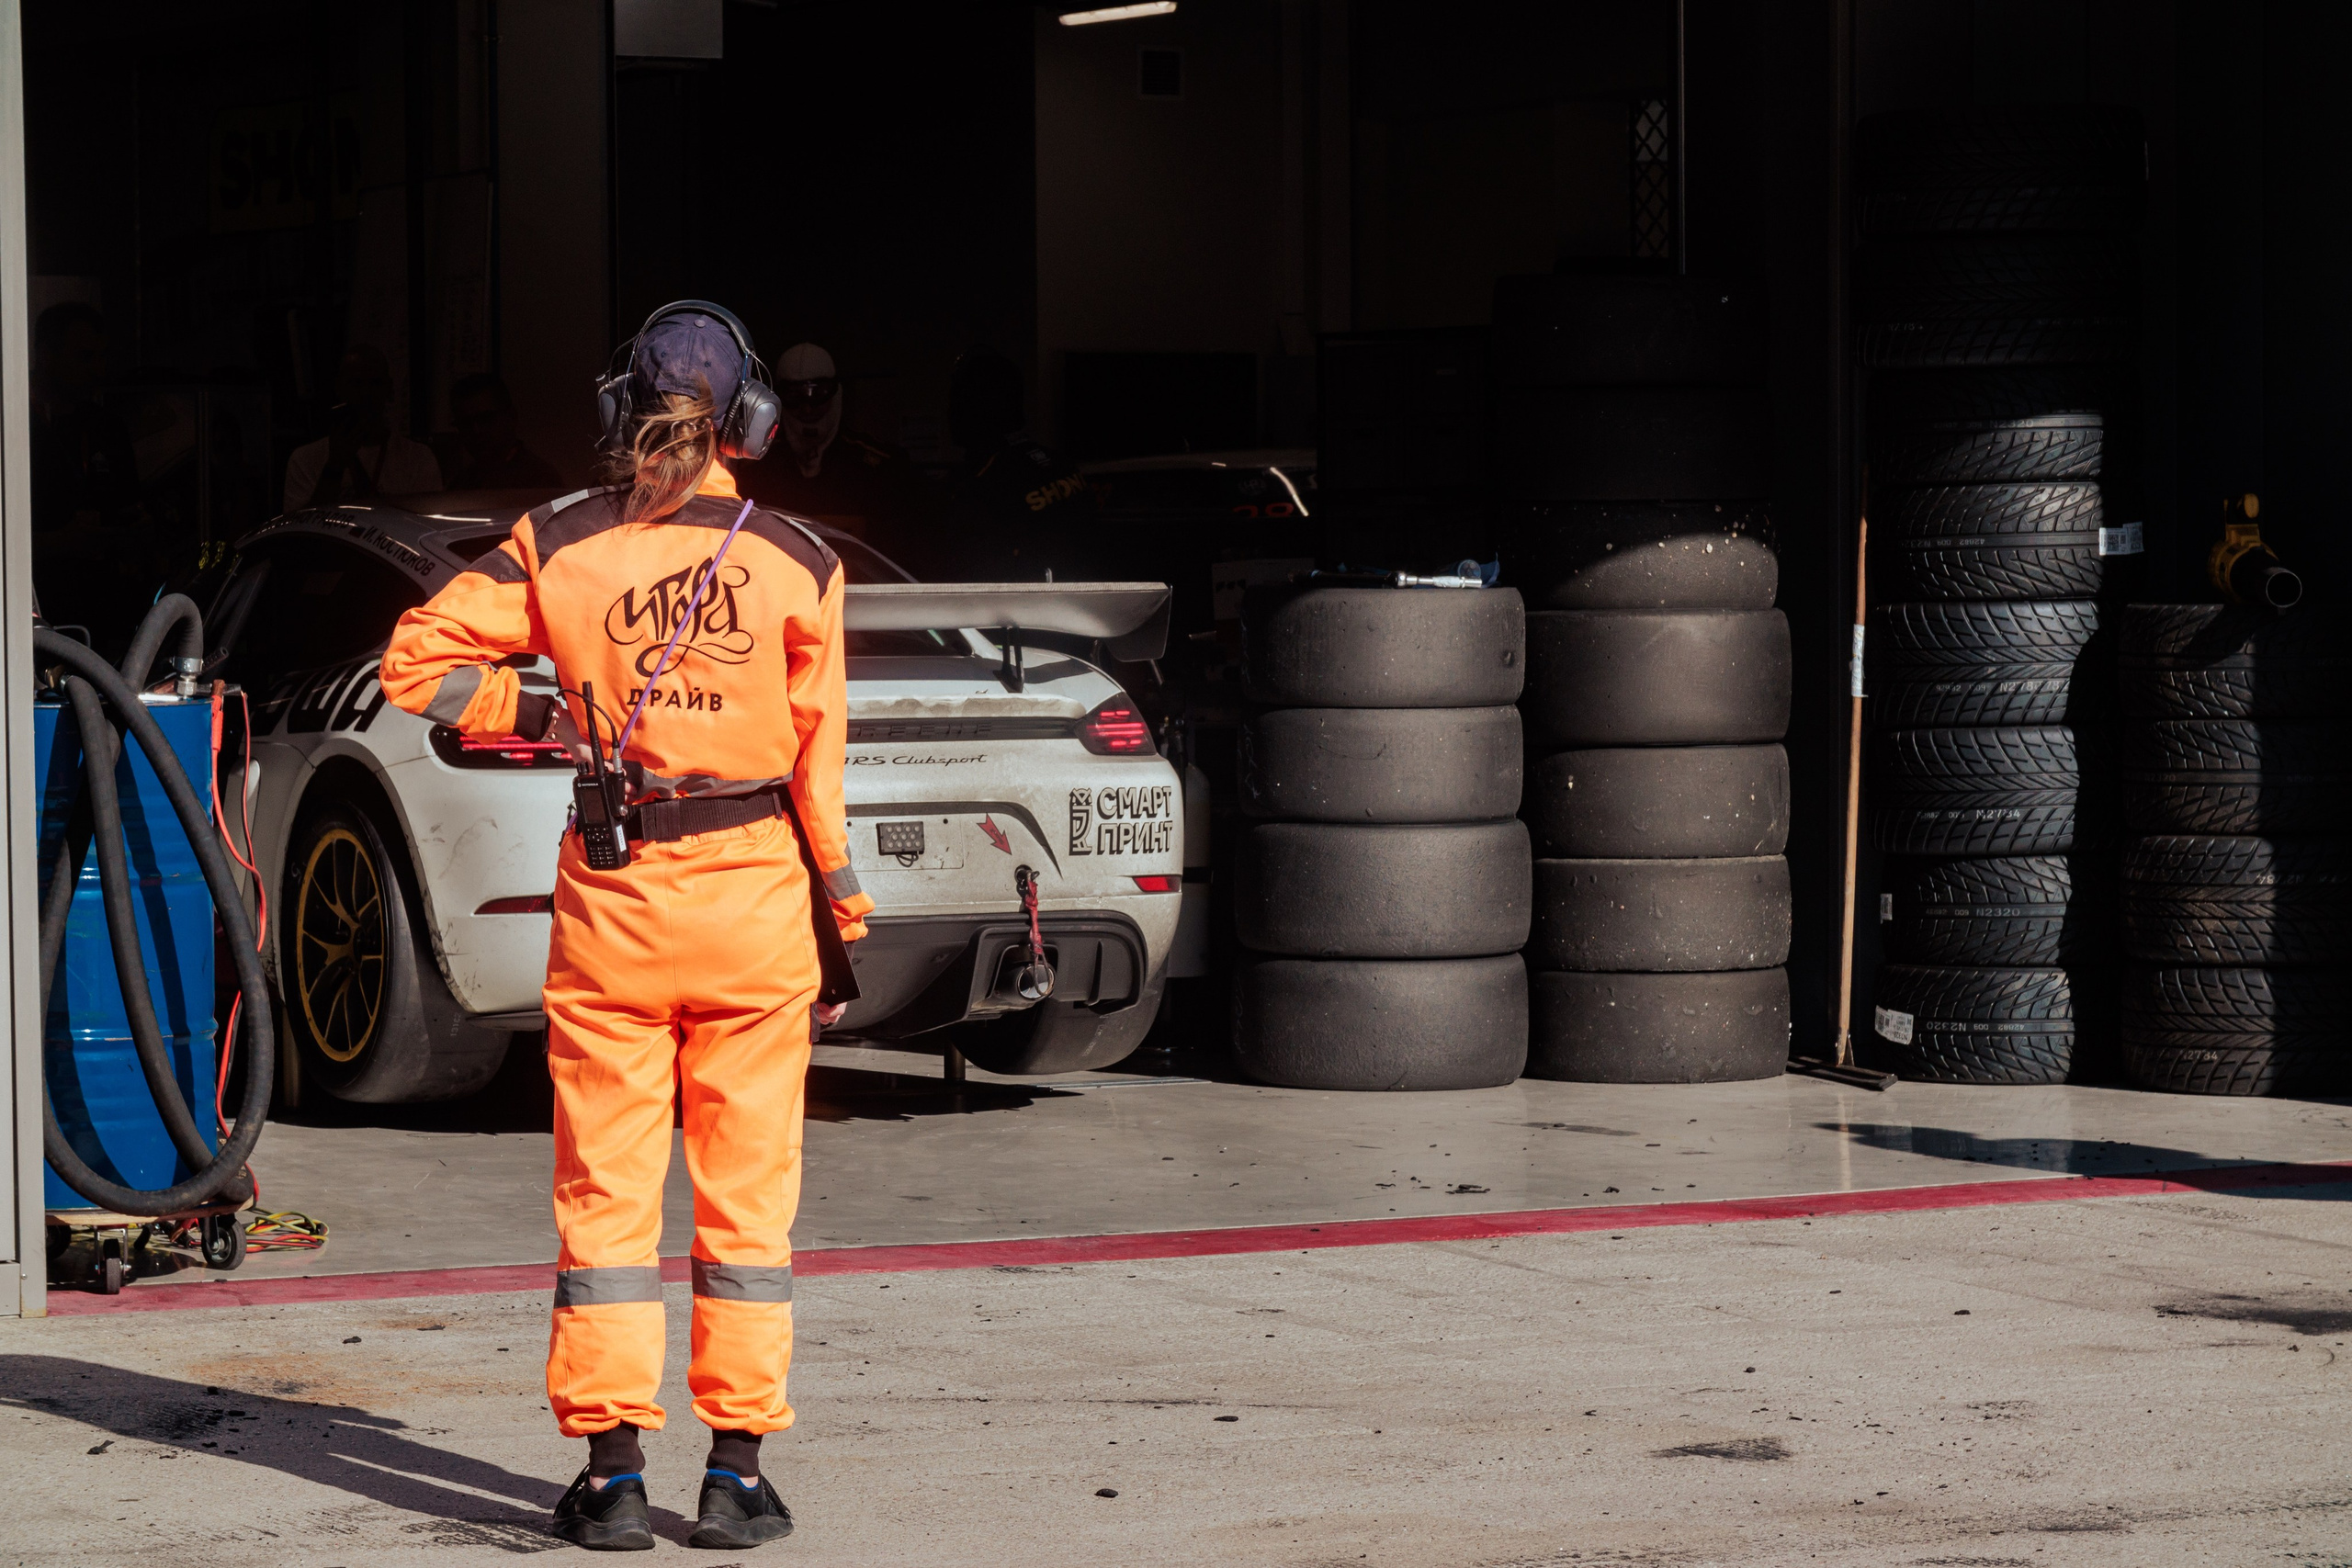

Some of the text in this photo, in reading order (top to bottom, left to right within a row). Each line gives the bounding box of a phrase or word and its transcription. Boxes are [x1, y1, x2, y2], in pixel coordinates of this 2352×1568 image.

[627, 687, 723, 712] ДРАЙВ
[857, 721, 993, 738] RSCHE
[891, 753, 988, 768] Clubsport
[1096, 785, 1172, 820] СМАРТ
[1096, 820, 1173, 855] ПРИНТ
[1976, 908, 2021, 918] N2320
[1927, 1021, 1967, 1032] N2320
